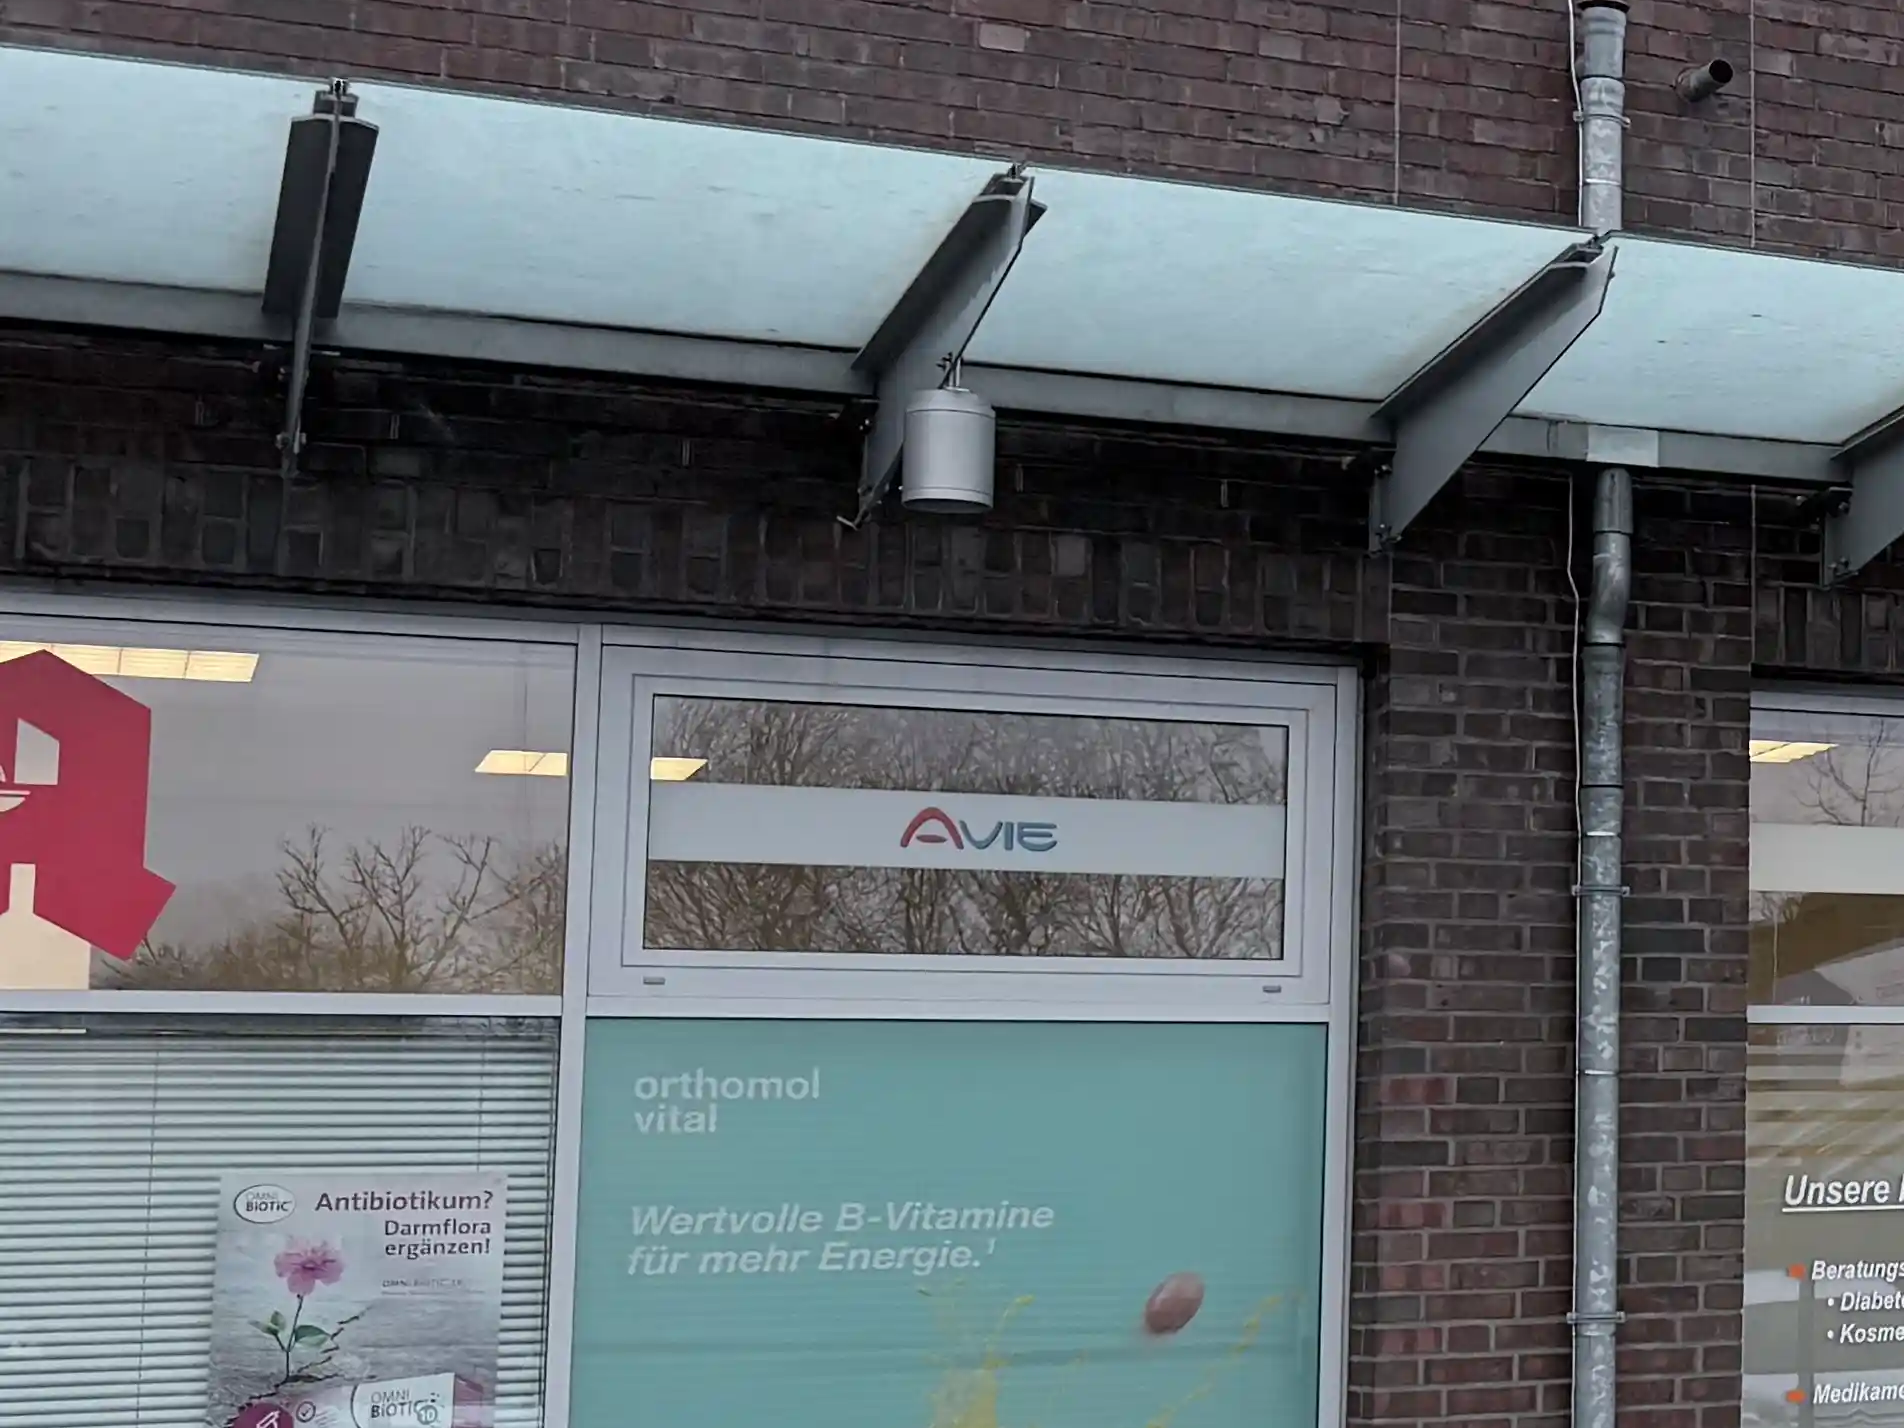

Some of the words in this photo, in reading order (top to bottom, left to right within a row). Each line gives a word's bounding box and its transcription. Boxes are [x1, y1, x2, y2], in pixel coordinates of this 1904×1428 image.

[633, 1067, 820, 1100] orthomol
[634, 1103, 718, 1133] vital
[315, 1190, 494, 1212] Antibiotikum?
[1784, 1173, 1890, 1206] Unsere
[384, 1220, 492, 1236] Darmflora
[631, 1204, 823, 1236] Wertvolle
[834, 1201, 1055, 1233] B-Vitamine
[384, 1239, 491, 1260] ergänzen!
[627, 1245, 689, 1276] für
[698, 1243, 810, 1274] mehr
